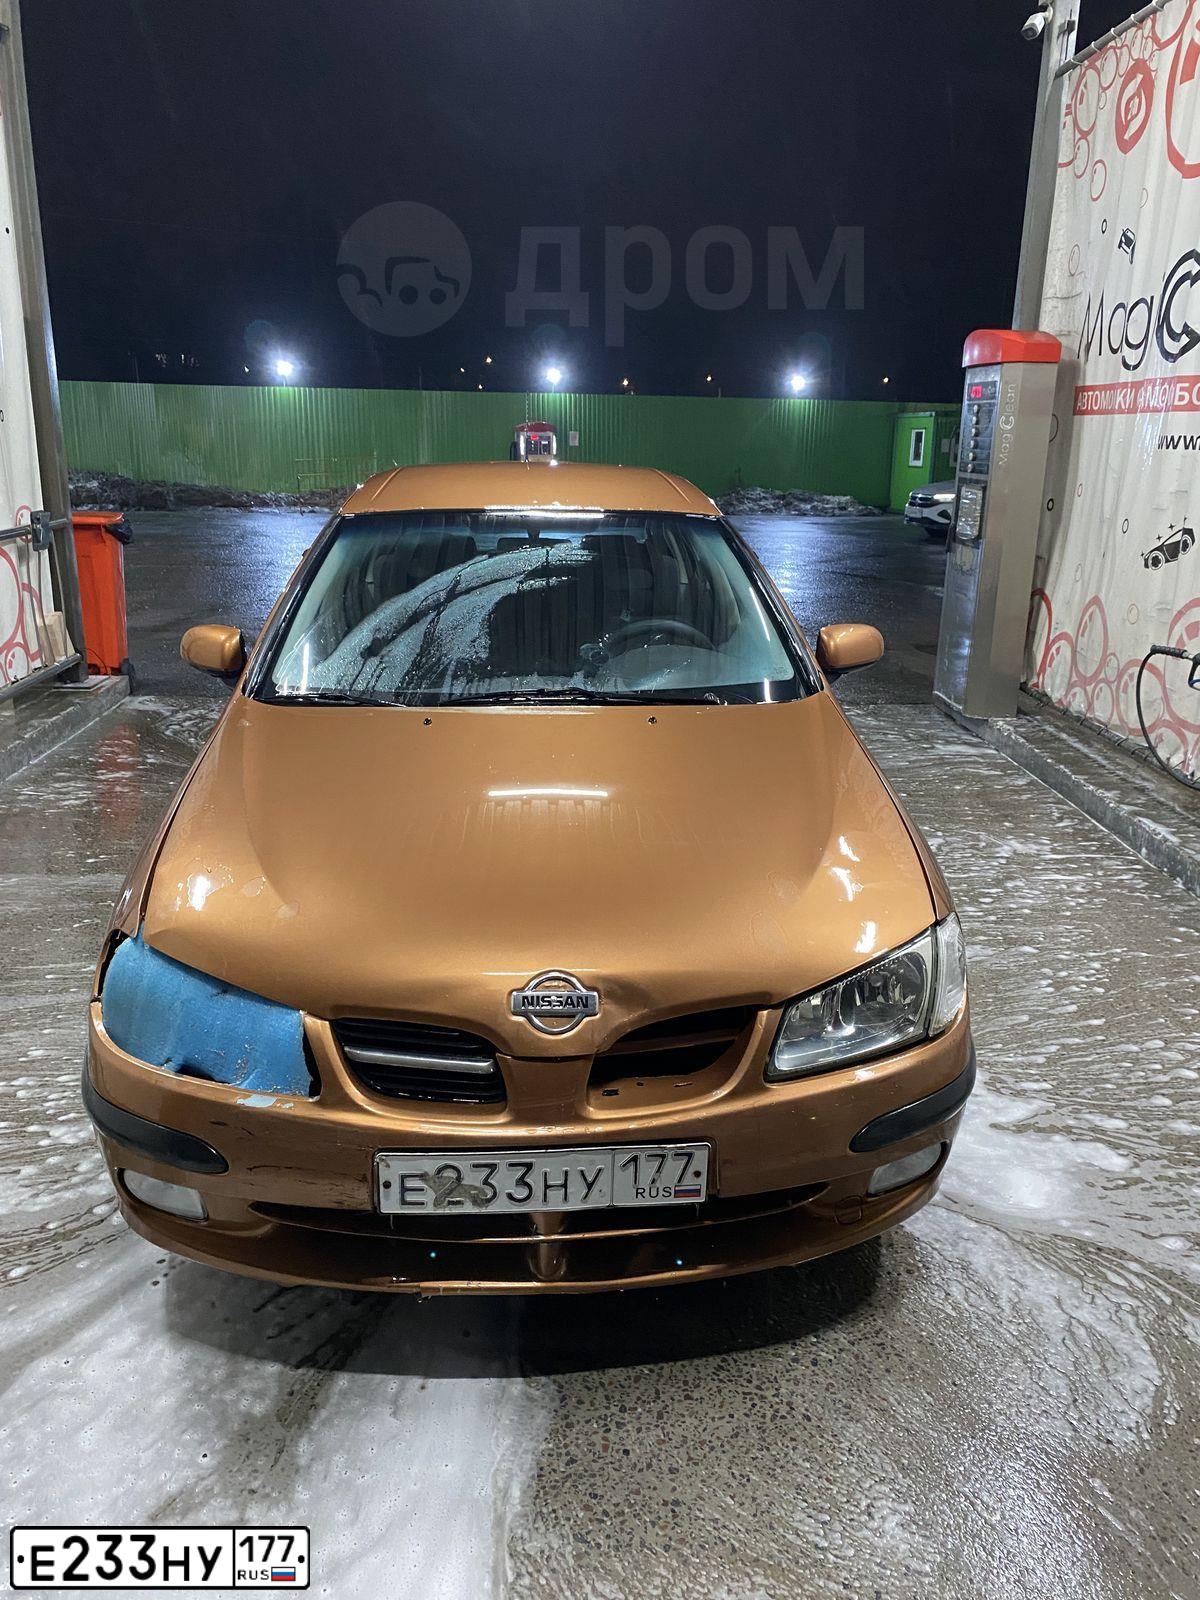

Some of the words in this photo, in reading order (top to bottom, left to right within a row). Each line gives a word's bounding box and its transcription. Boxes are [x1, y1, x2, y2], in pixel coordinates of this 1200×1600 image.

[521, 995, 589, 1009] NISSAN
[620, 1151, 695, 1186] 177
[635, 1186, 672, 1199] RUS
